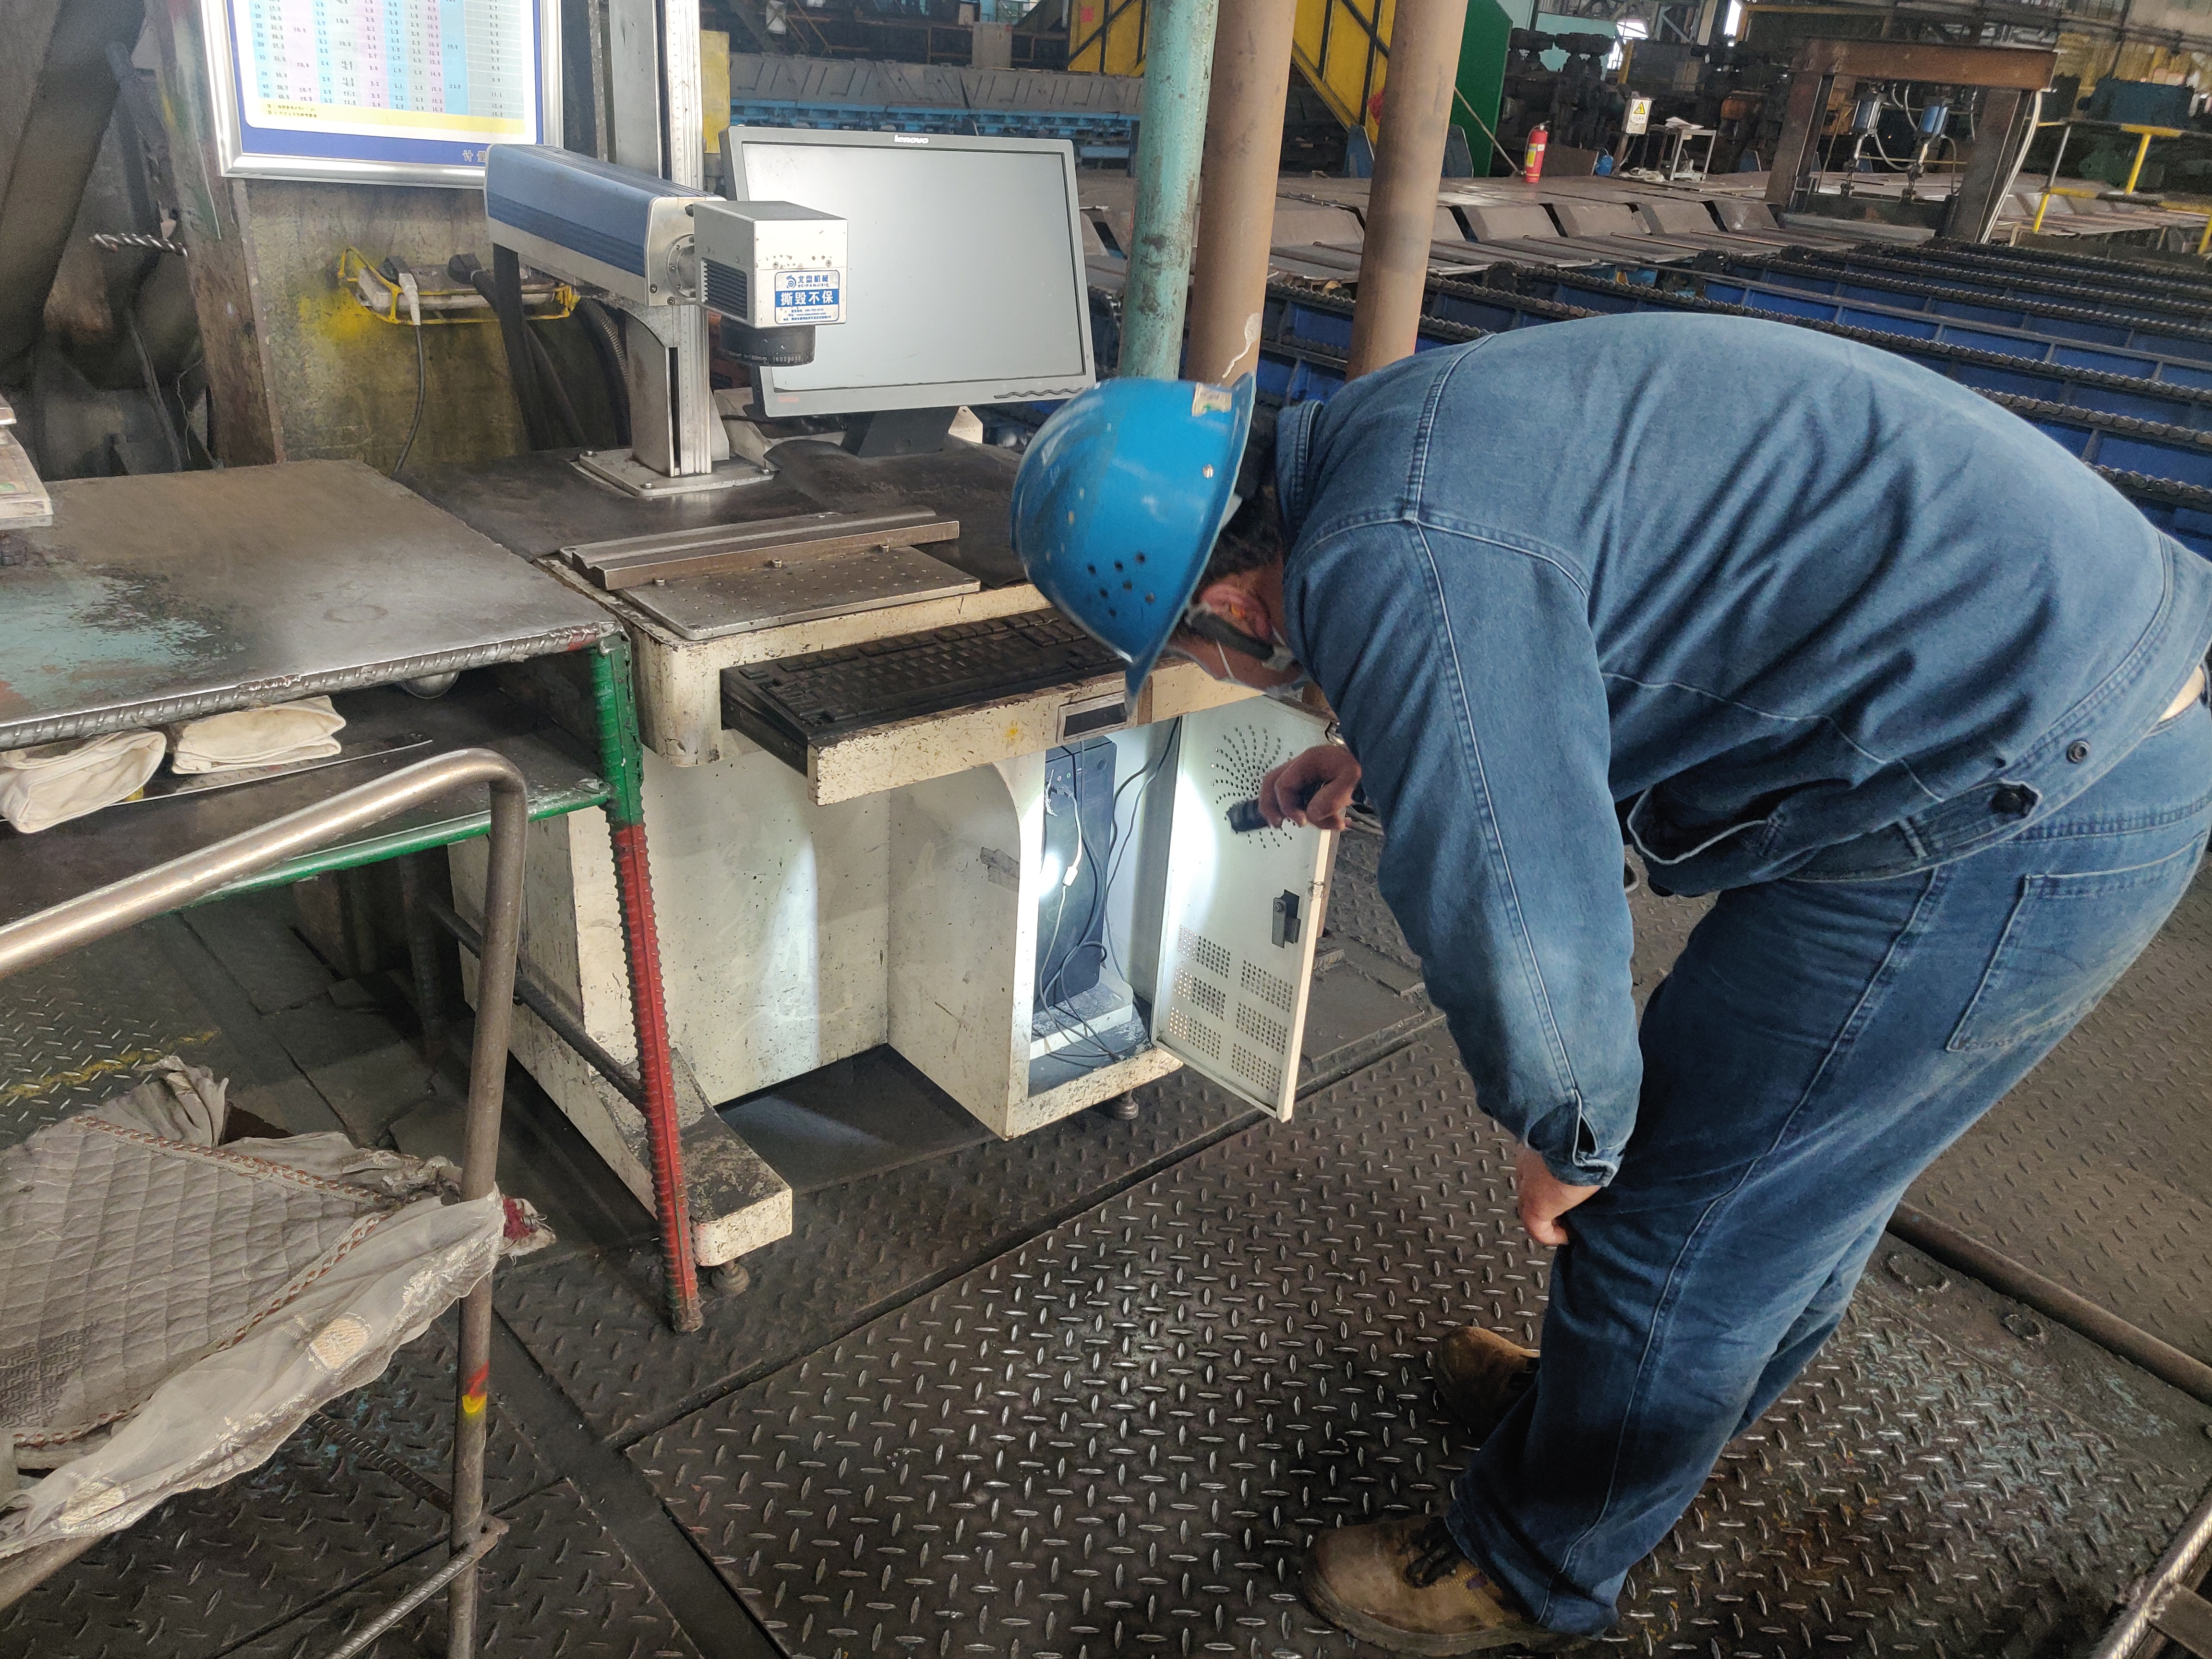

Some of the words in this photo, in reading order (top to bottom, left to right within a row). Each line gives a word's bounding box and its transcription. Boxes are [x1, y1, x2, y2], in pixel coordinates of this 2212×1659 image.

[894, 134, 929, 144] lenovo
[781, 290, 833, 306] 撕毁不保
